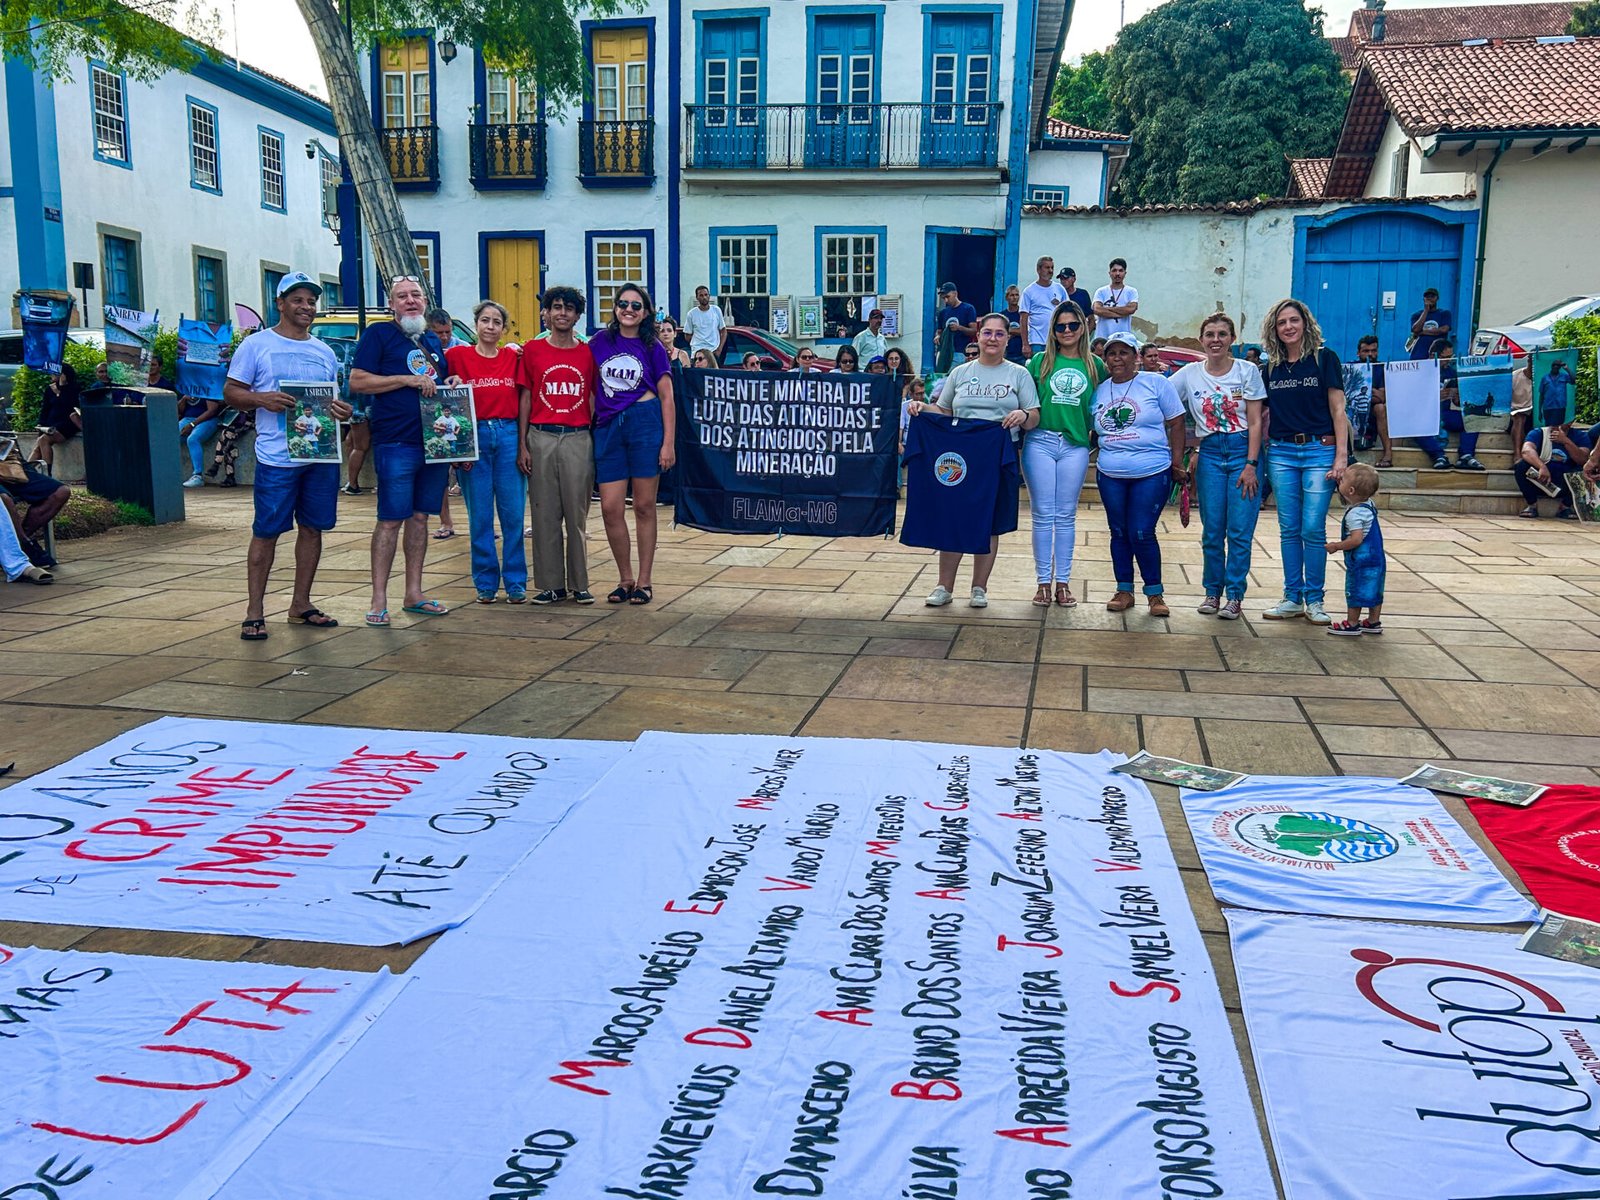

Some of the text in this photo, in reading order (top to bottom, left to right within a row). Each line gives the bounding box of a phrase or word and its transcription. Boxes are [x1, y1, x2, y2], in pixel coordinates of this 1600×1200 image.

[606, 367, 636, 380] MAM
[1395, 362, 1420, 372] SIRENE
[310, 387, 332, 397] SIRENE
[448, 389, 468, 398] SIRENE
[545, 382, 581, 397] MAM
[704, 376, 872, 405] FRENTE MINEIRA DE
[693, 399, 881, 429] LUTA DAS ATINGIDAS E
[700, 424, 874, 453] DOS ATINGIDOS PELA
[736, 451, 836, 478] MINERAÇÃO
[32, 740, 228, 808] ANOS
[748, 748, 805, 775] XAVIER
[734, 775, 788, 811] MARCOS
[14, 765, 295, 896] DE CRIME
[157, 745, 469, 889] IMPUNIDADE
[704, 823, 767, 852] JOSÉ
[865, 812, 905, 858] MATEUS
[759, 847, 824, 892] VANDO
[914, 840, 970, 874] CLARA
[1252, 852, 1336, 871] MOVIMENTO
[848, 860, 901, 902] SANTOS
[915, 874, 971, 901] ANA
[840, 903, 888, 931] DOS
[997, 892, 1064, 958] JOAQUIM
[1098, 885, 1168, 928] VIEIRA
[720, 904, 805, 981] ALTAMIRO
[829, 934, 884, 984] CLARA
[904, 913, 965, 973] SANTOS
[610, 930, 704, 1002] AURÉLIO
[1108, 931, 1182, 1003] SAMUEL
[683, 981, 776, 1049] DANIEL
[814, 985, 877, 1027] ANA
[900, 977, 962, 1019] DOS
[997, 970, 1068, 1032] VIEIRA
[31, 979, 339, 1145] LUTA
[548, 1001, 663, 1095] MARCOS
[890, 1025, 963, 1101] BRUNO
[1559, 1029, 1599, 1062] SINDICAL
[1136, 1022, 1206, 1118] AUGUSTO
[992, 1037, 1072, 1148] APARECIDA
[753, 1059, 856, 1198] DAMASCENO
[489, 1128, 578, 1200] ARCIO
[901, 1145, 967, 1200] ILVA
